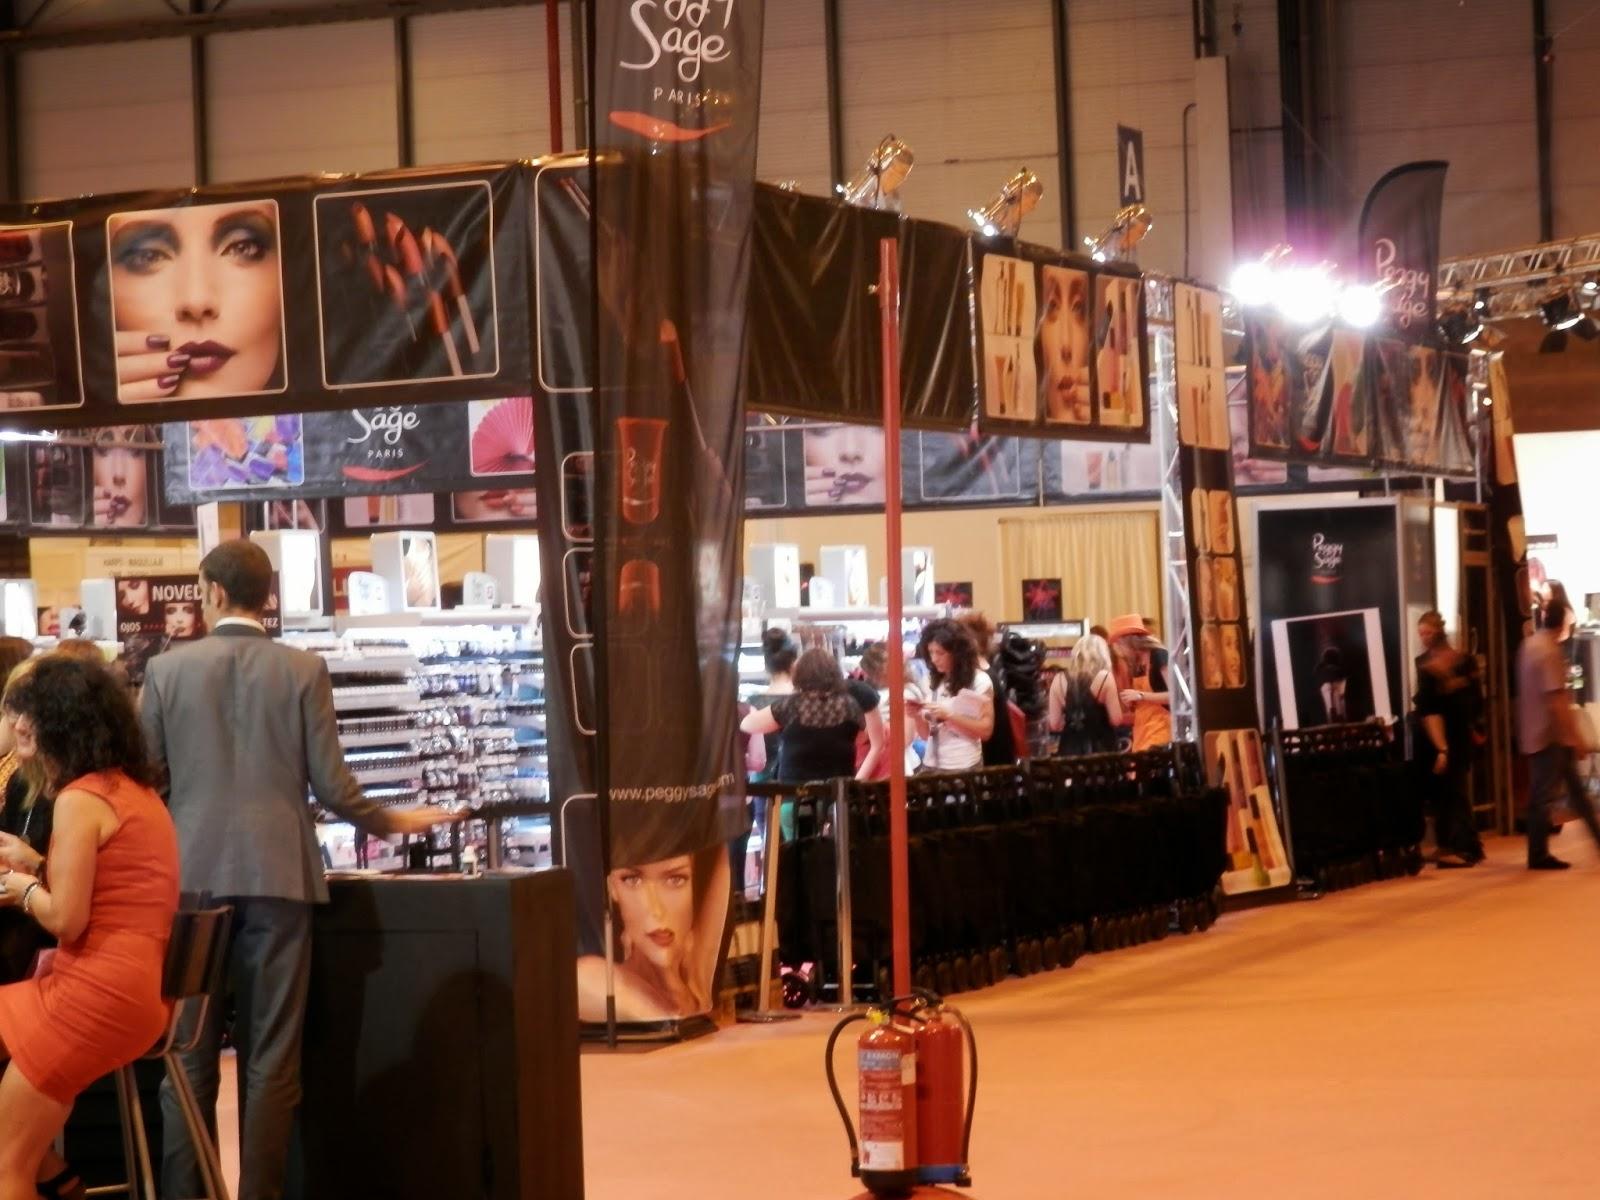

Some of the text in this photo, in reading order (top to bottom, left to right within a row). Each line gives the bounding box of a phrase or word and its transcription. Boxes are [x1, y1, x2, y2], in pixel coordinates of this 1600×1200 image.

[619, 0, 732, 82] Sage
[653, 86, 701, 108] PARIS
[1123, 140, 1142, 201] A
[366, 448, 404, 459] PARIS
